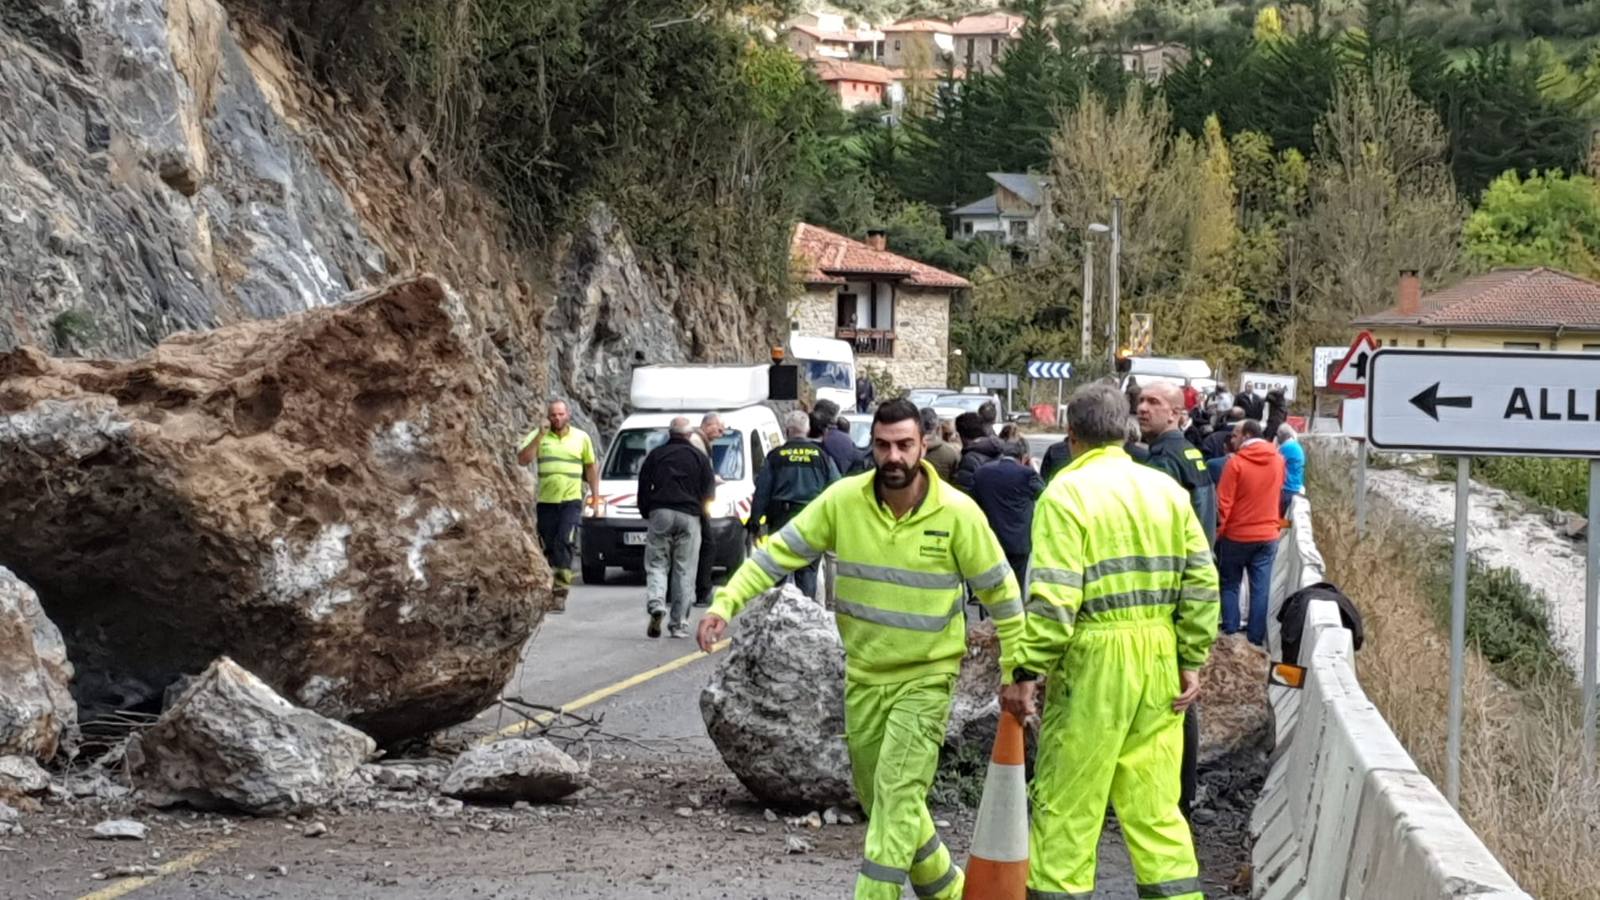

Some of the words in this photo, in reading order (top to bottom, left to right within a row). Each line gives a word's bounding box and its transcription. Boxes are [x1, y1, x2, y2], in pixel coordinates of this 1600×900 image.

[1503, 387, 1600, 421] ALL
[779, 448, 819, 457] GUARDIA
[788, 455, 811, 463] CIVIL
